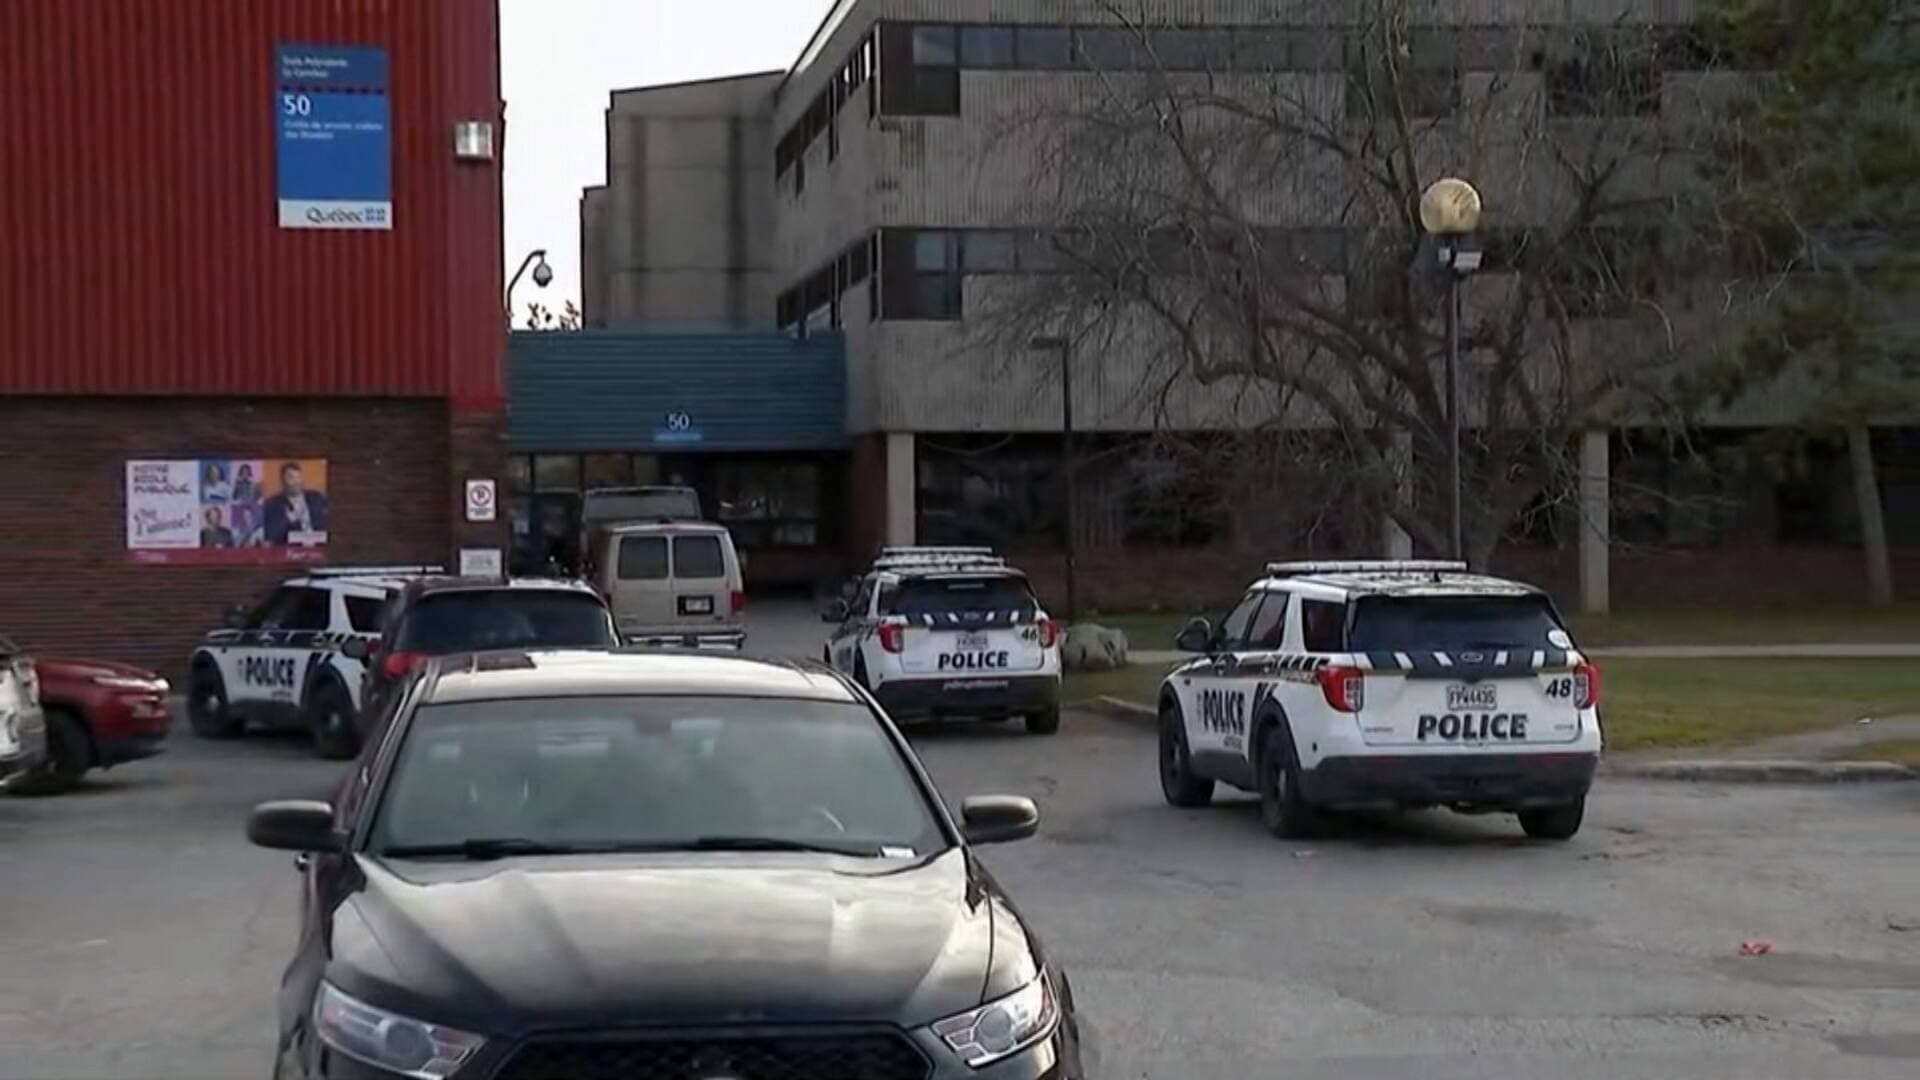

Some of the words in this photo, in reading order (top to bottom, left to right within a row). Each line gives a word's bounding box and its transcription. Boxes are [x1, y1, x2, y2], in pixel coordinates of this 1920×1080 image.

[283, 94, 311, 116] 50
[669, 413, 689, 431] 50
[1021, 627, 1038, 641] 46
[938, 650, 1009, 670] POLICE
[246, 655, 295, 688] POLICE
[1545, 678, 1572, 698] 48
[1203, 689, 1245, 736] POLICE
[1416, 713, 1528, 741] POLICE
